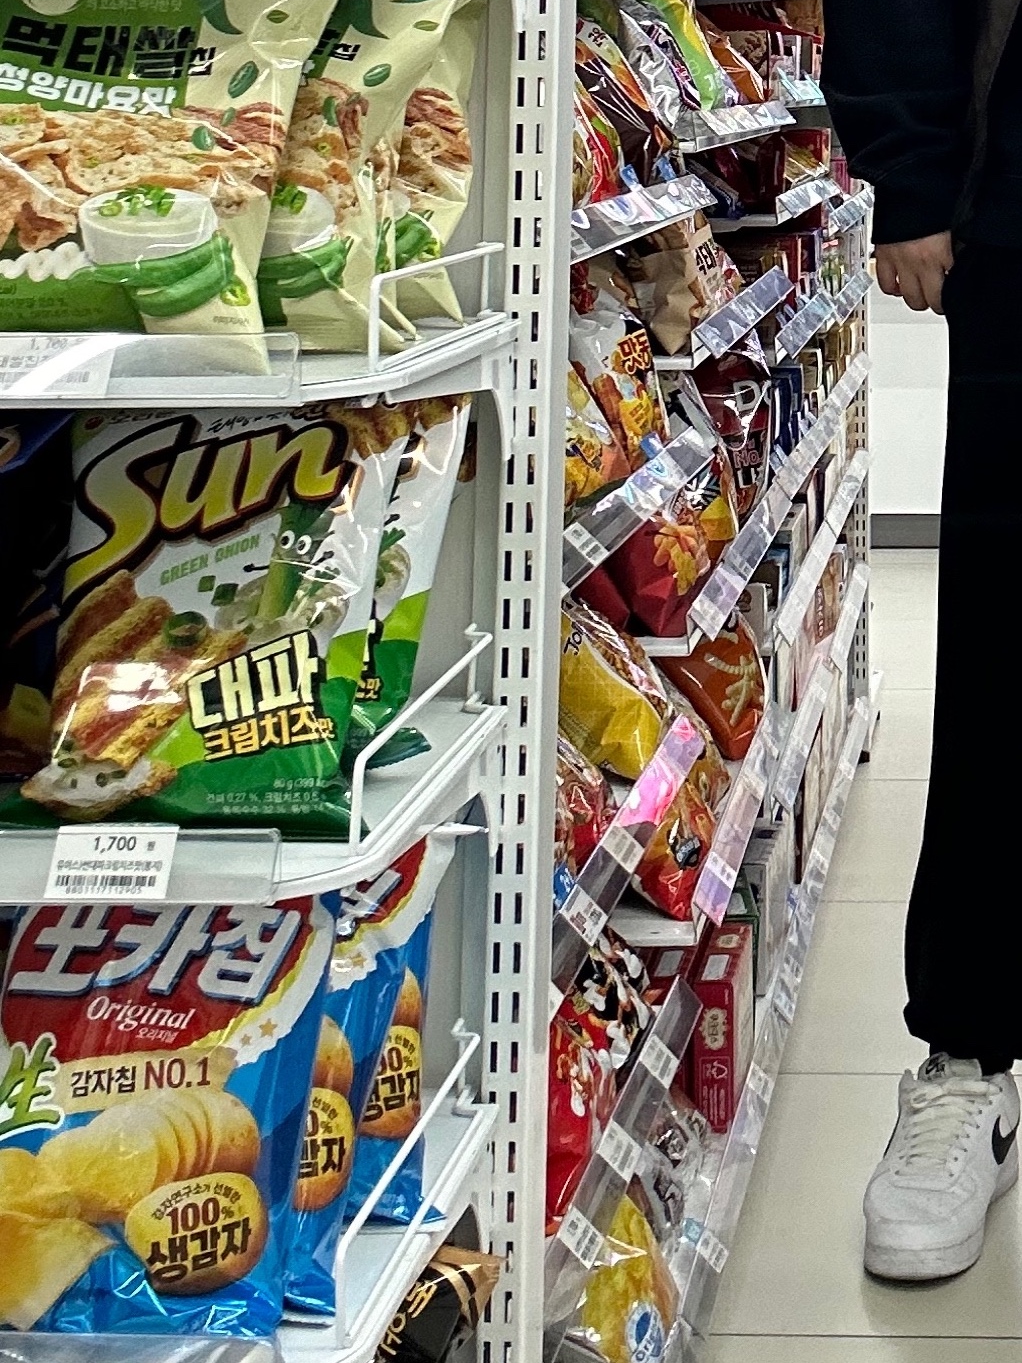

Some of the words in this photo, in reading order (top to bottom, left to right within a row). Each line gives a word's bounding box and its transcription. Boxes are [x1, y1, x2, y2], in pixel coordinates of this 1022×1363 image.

[64, 414, 350, 603] Sun
[160, 554, 209, 586] GREEN
[187, 630, 324, 729] 대파
[95, 836, 137, 854] 1,700
[87, 994, 197, 1035] Original
[71, 1065, 136, 1097] 감자칩
[144, 1056, 212, 1090] NO.1
[146, 1216, 252, 1284] 생감자
